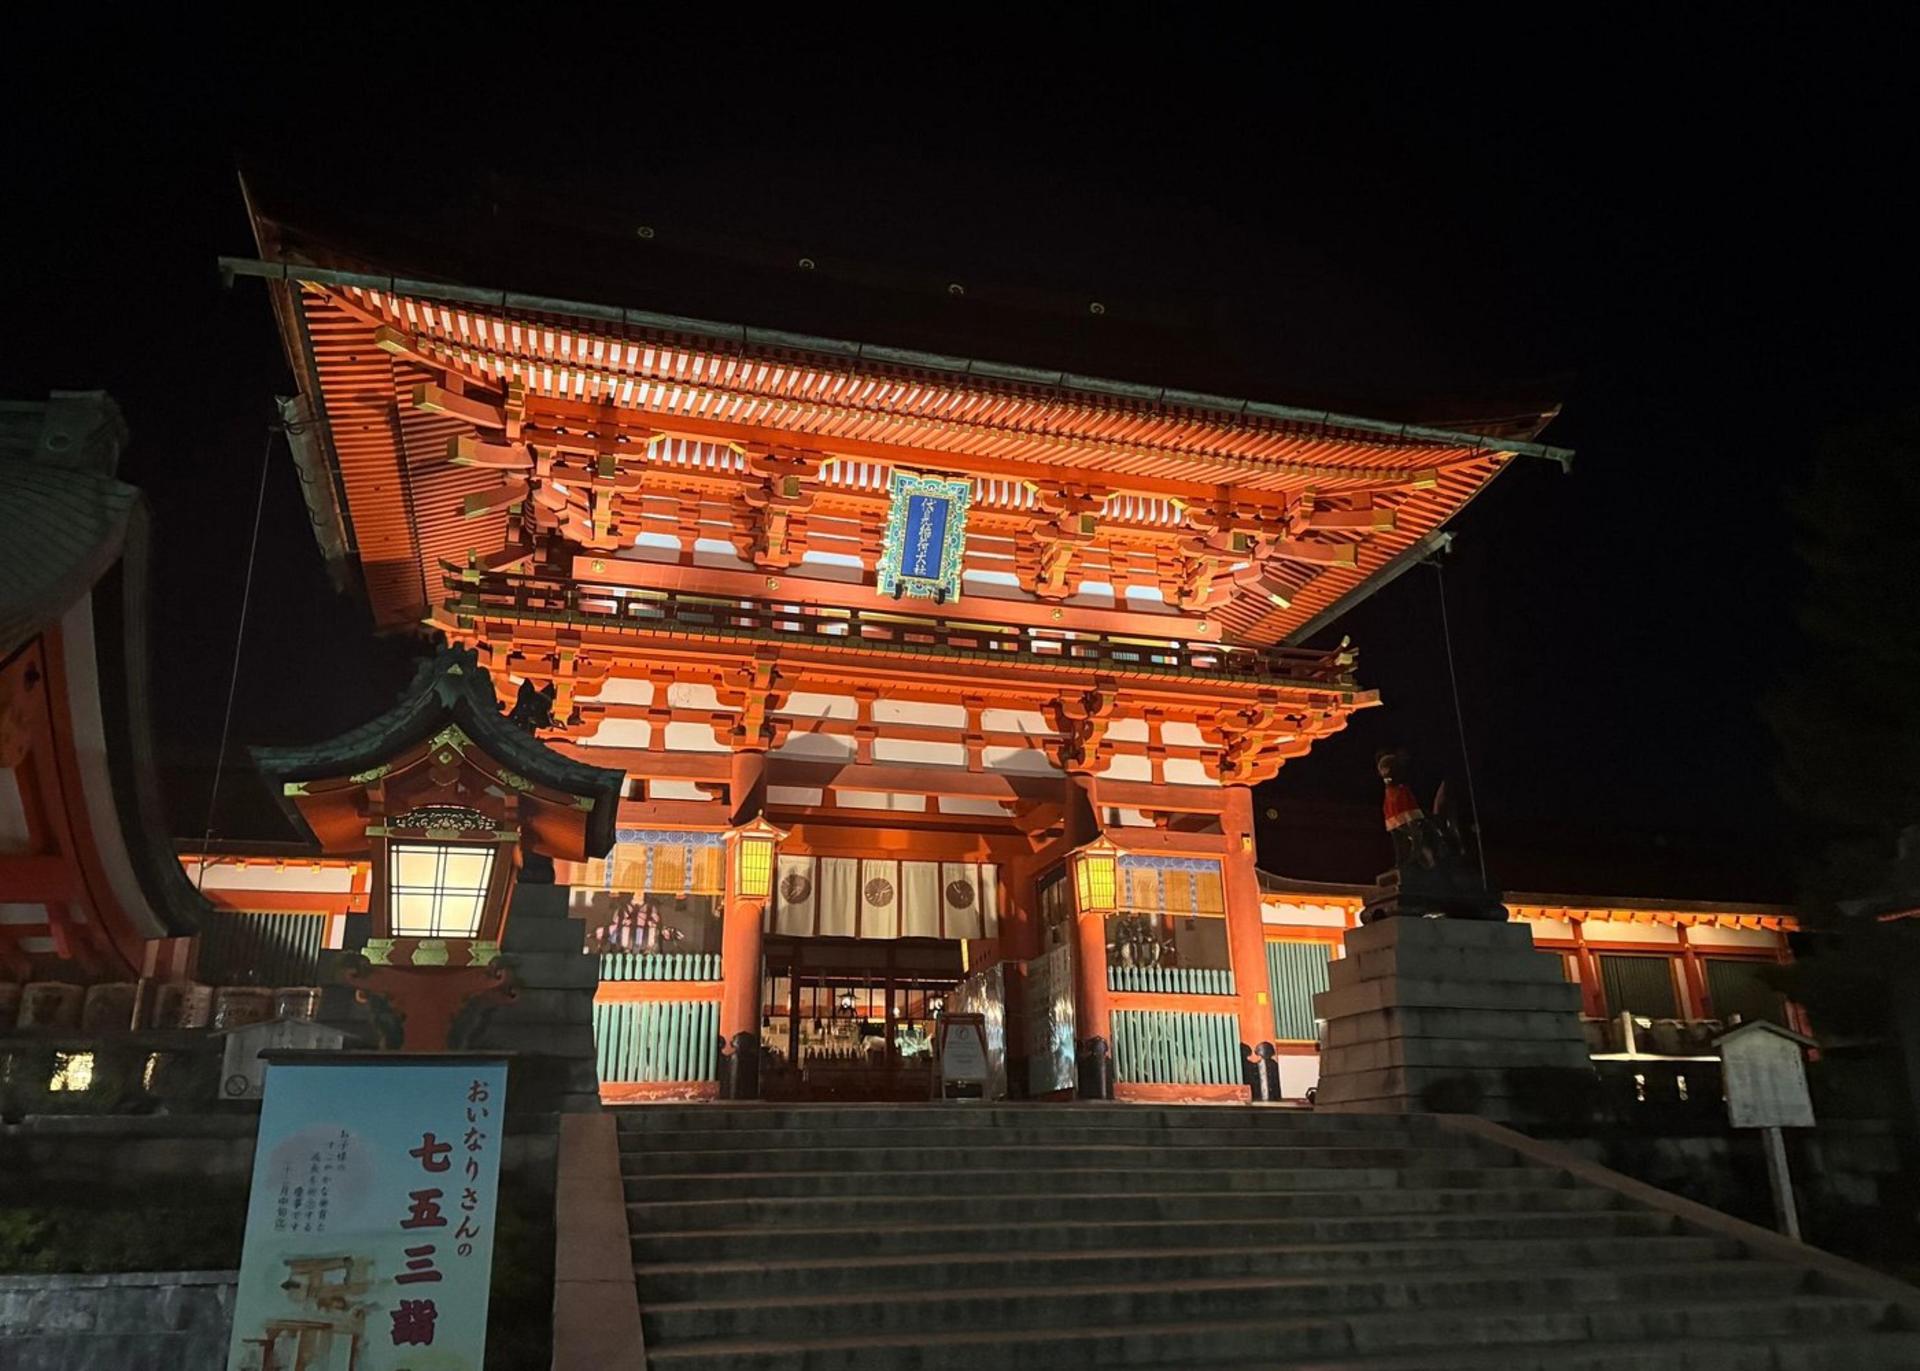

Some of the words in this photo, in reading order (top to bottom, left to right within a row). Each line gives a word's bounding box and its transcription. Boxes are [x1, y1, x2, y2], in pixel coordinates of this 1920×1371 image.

[390, 1132, 453, 1346] 七五三詣
[455, 1080, 489, 1257] おいなりさんの
